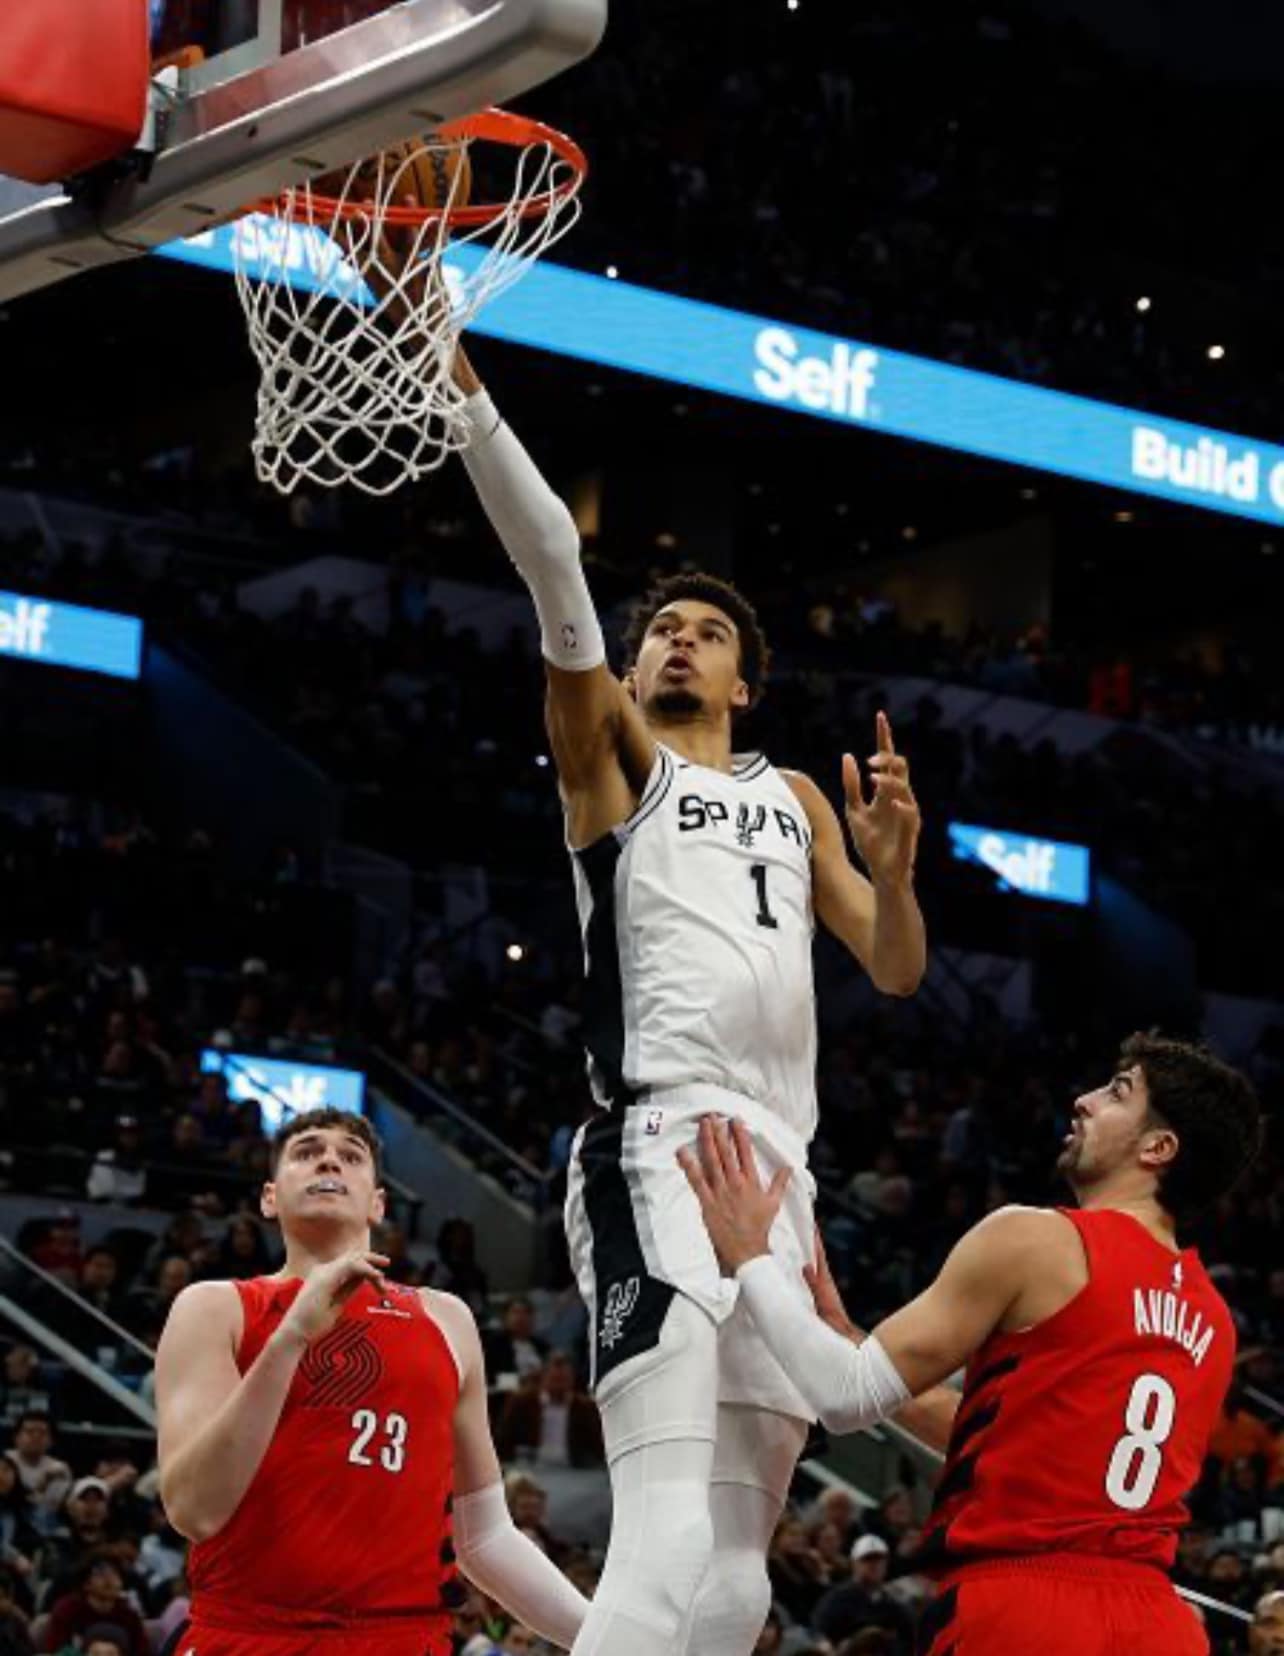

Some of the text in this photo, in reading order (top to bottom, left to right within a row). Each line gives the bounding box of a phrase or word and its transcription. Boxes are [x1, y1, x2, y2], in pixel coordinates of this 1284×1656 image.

[753, 327, 879, 419] Self
[1132, 426, 1259, 502] Build
[750, 865, 778, 929] 1
[977, 833, 1056, 891] Self
[1133, 1287, 1215, 1367] AVDIJA
[348, 1409, 408, 1473] 23
[1105, 1374, 1176, 1511] 8
